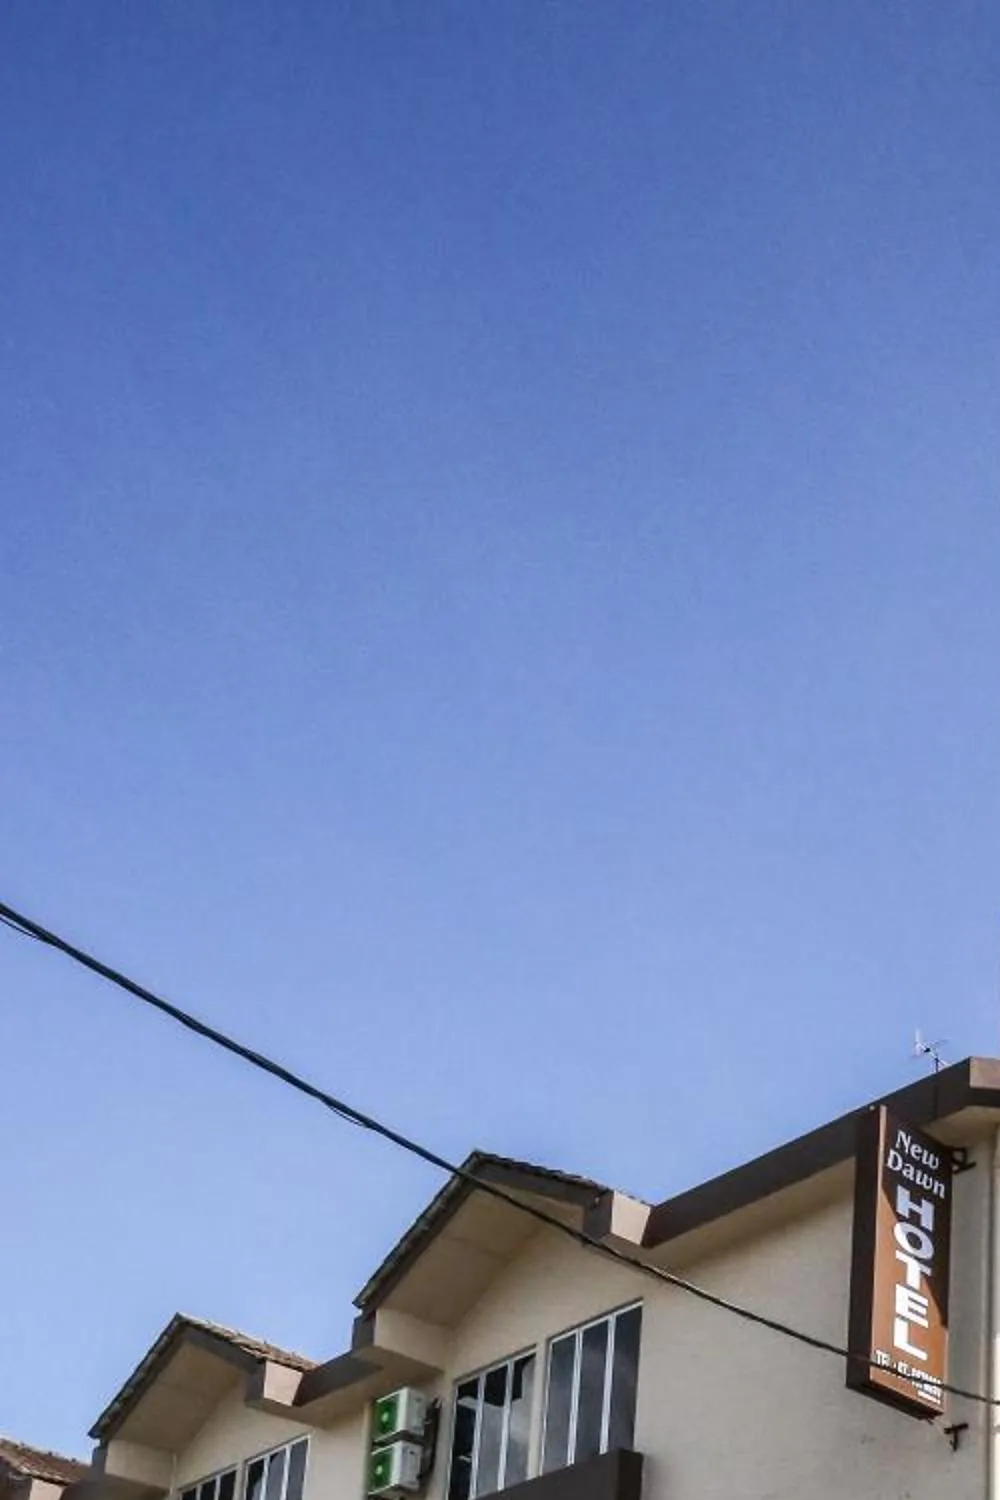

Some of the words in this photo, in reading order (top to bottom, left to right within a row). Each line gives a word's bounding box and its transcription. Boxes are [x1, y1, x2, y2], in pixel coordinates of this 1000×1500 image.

[887, 1150, 946, 1198] Dawn
[897, 1130, 940, 1170] New
[893, 1185, 935, 1361] HOTEL
